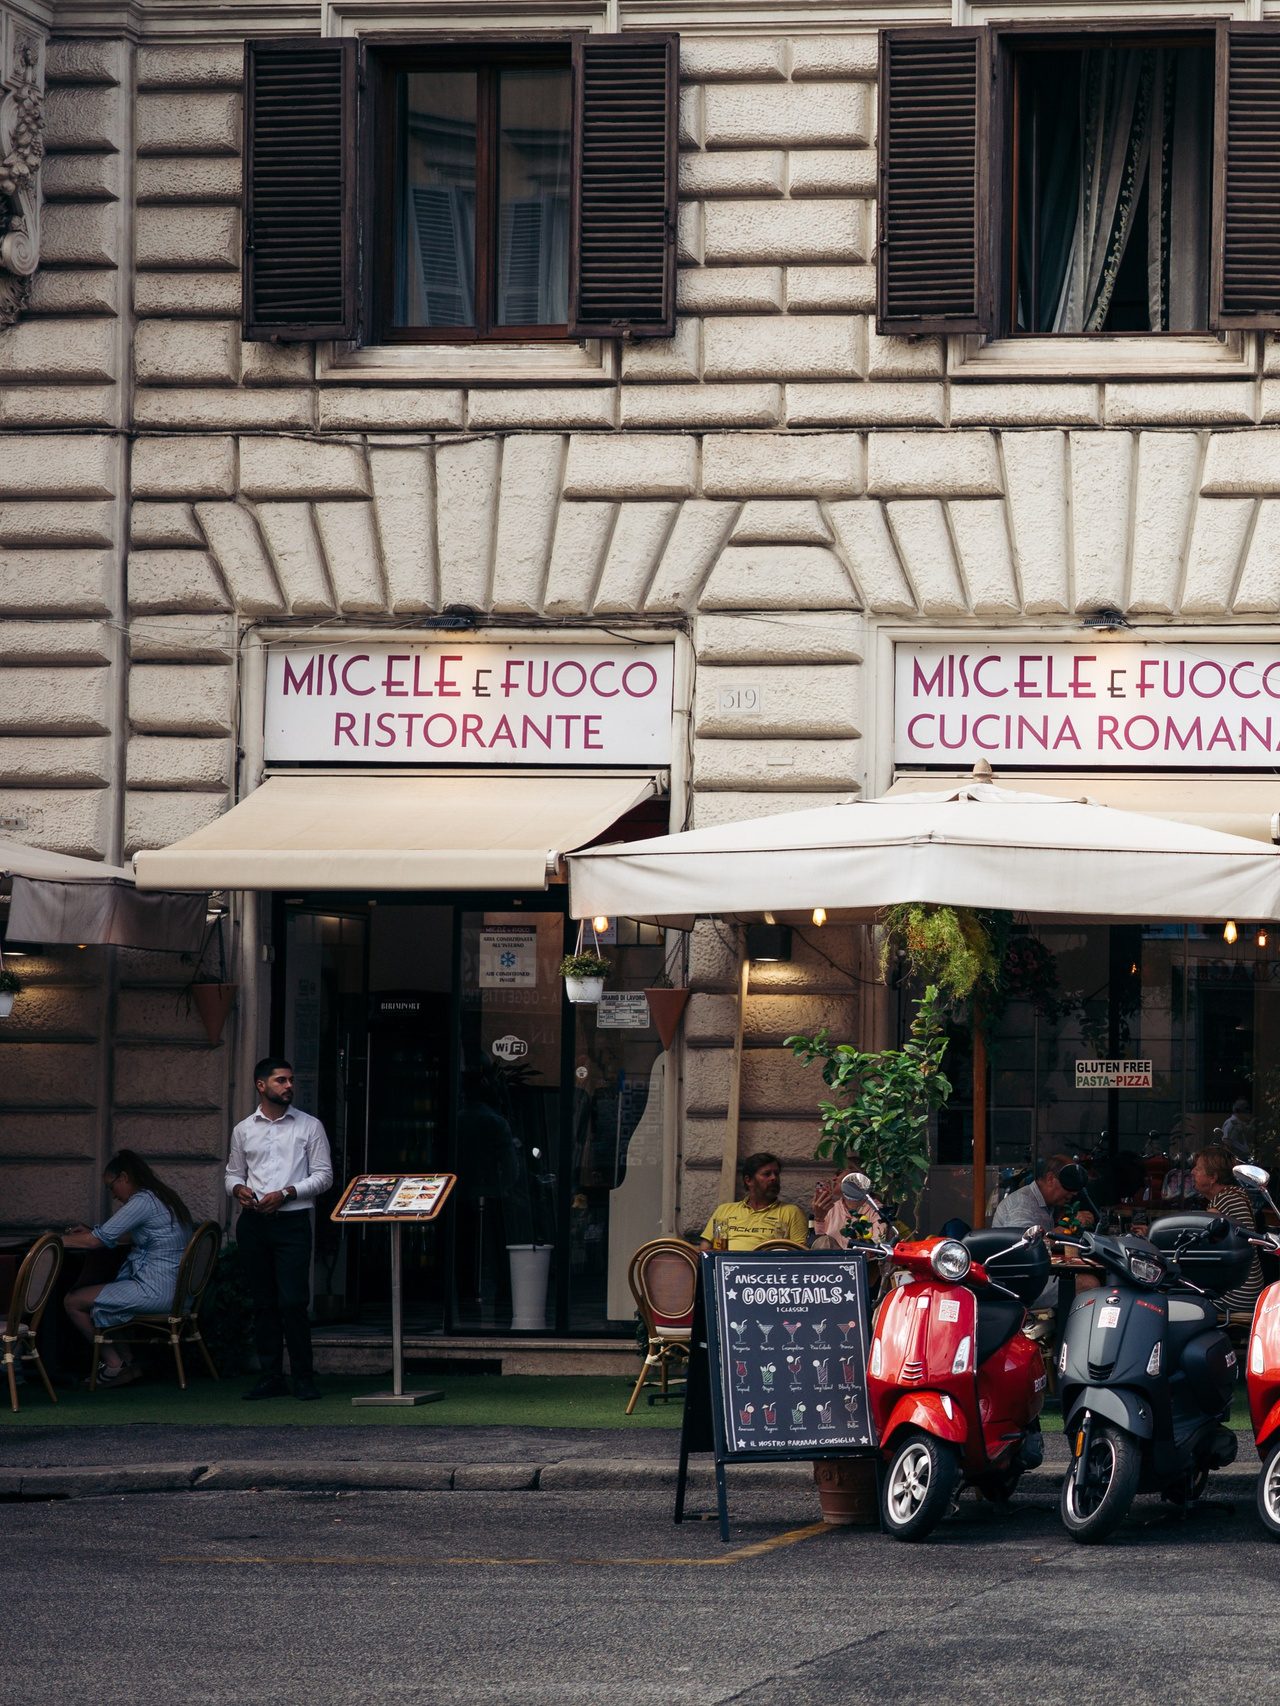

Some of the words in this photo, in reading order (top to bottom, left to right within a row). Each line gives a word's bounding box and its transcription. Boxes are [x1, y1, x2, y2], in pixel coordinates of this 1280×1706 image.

[283, 653, 463, 698] MISCELE
[473, 669, 492, 698] E
[500, 660, 658, 699] FUOCO
[912, 655, 1097, 698] MISCELE
[1107, 669, 1127, 698] E
[722, 688, 757, 710] 319
[334, 712, 604, 749] RISTORANTE
[907, 713, 1082, 750] CUCINA
[380, 1002, 422, 1010] BIRIMPORT
[1076, 1061, 1121, 1074] GLUTEN
[1122, 1061, 1151, 1073] FREE
[726, 1226, 775, 1234] ACKETT
[791, 1274, 799, 1284] E
[803, 1274, 843, 1284] FUOCO
[742, 1287, 843, 1305] COCKTAILS
